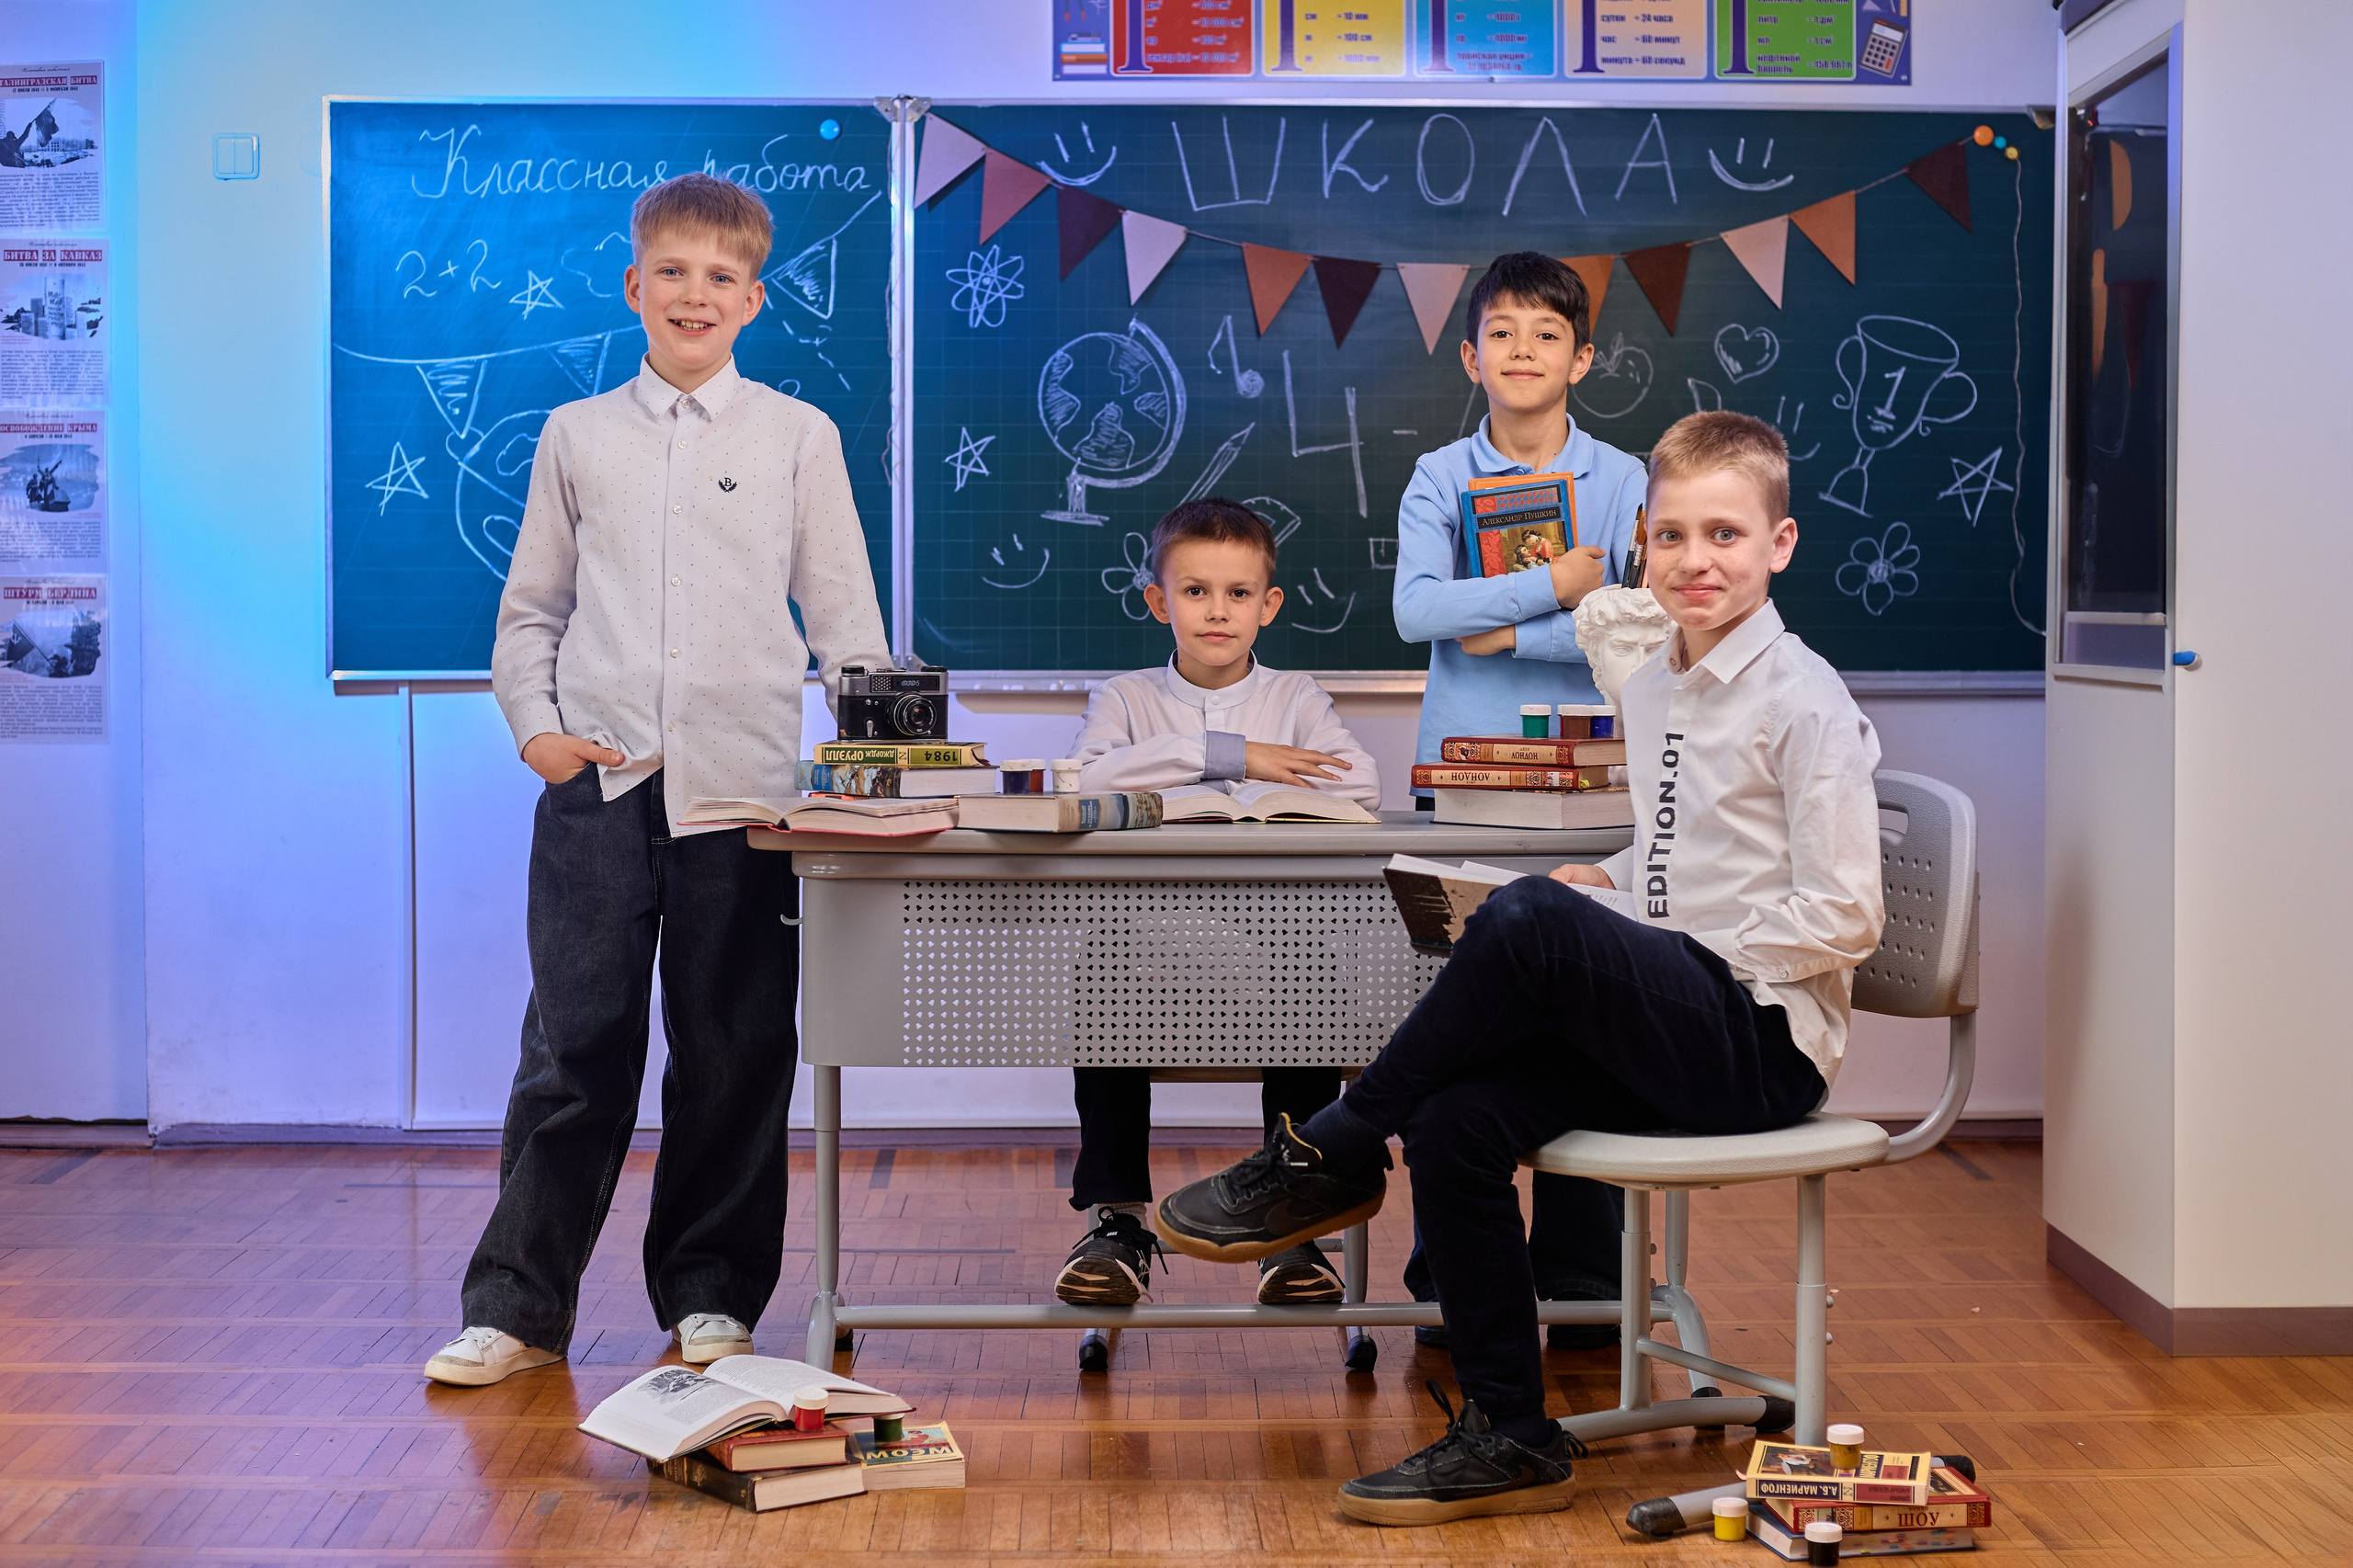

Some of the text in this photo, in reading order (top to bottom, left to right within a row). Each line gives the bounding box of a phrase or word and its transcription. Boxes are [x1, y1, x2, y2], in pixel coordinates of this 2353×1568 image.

[1600, 14, 1626, 24] сутки
[1653, 15, 1674, 23] часа
[1756, 16, 1779, 25] литр
[1600, 36, 1617, 44] час
[1642, 35, 1653, 44] 60
[1654, 36, 1680, 45] минут
[1600, 56, 1633, 65] минута
[1642, 55, 1653, 64] 60
[1654, 56, 1686, 66] секунд
[1756, 52, 1801, 62] нефтяной
[1756, 64, 1793, 74] баррель
[71, 76, 97, 85] БИТВА
[412, 124, 667, 199] Классная
[1171, 111, 1677, 216] ШКОЛА
[5, 251, 102, 260] БИТВА ЗА КАВКАЗ
[0, 424, 97, 433] ОСВОБОЖДЕНИЕ КРЫМА
[1482, 509, 1557, 527] АЛЕКСАНДР ПУШКИН
[47, 588, 97, 598] БЕРЛИНА
[825, 749, 895, 761] ДЖОРДЖ ОРУЭЛЛ
[925, 751, 958, 762] 1984
[1511, 752, 1538, 760] ЛОНДОН
[1451, 771, 1490, 781] ЛОНДОН
[1647, 733, 1685, 918] EDITION.01
[866, 1447, 954, 1460] МОЭМ
[1760, 1483, 1838, 1496] А.Б. МАРИЕНГОФ
[1898, 1512, 1940, 1528] ШОУ
